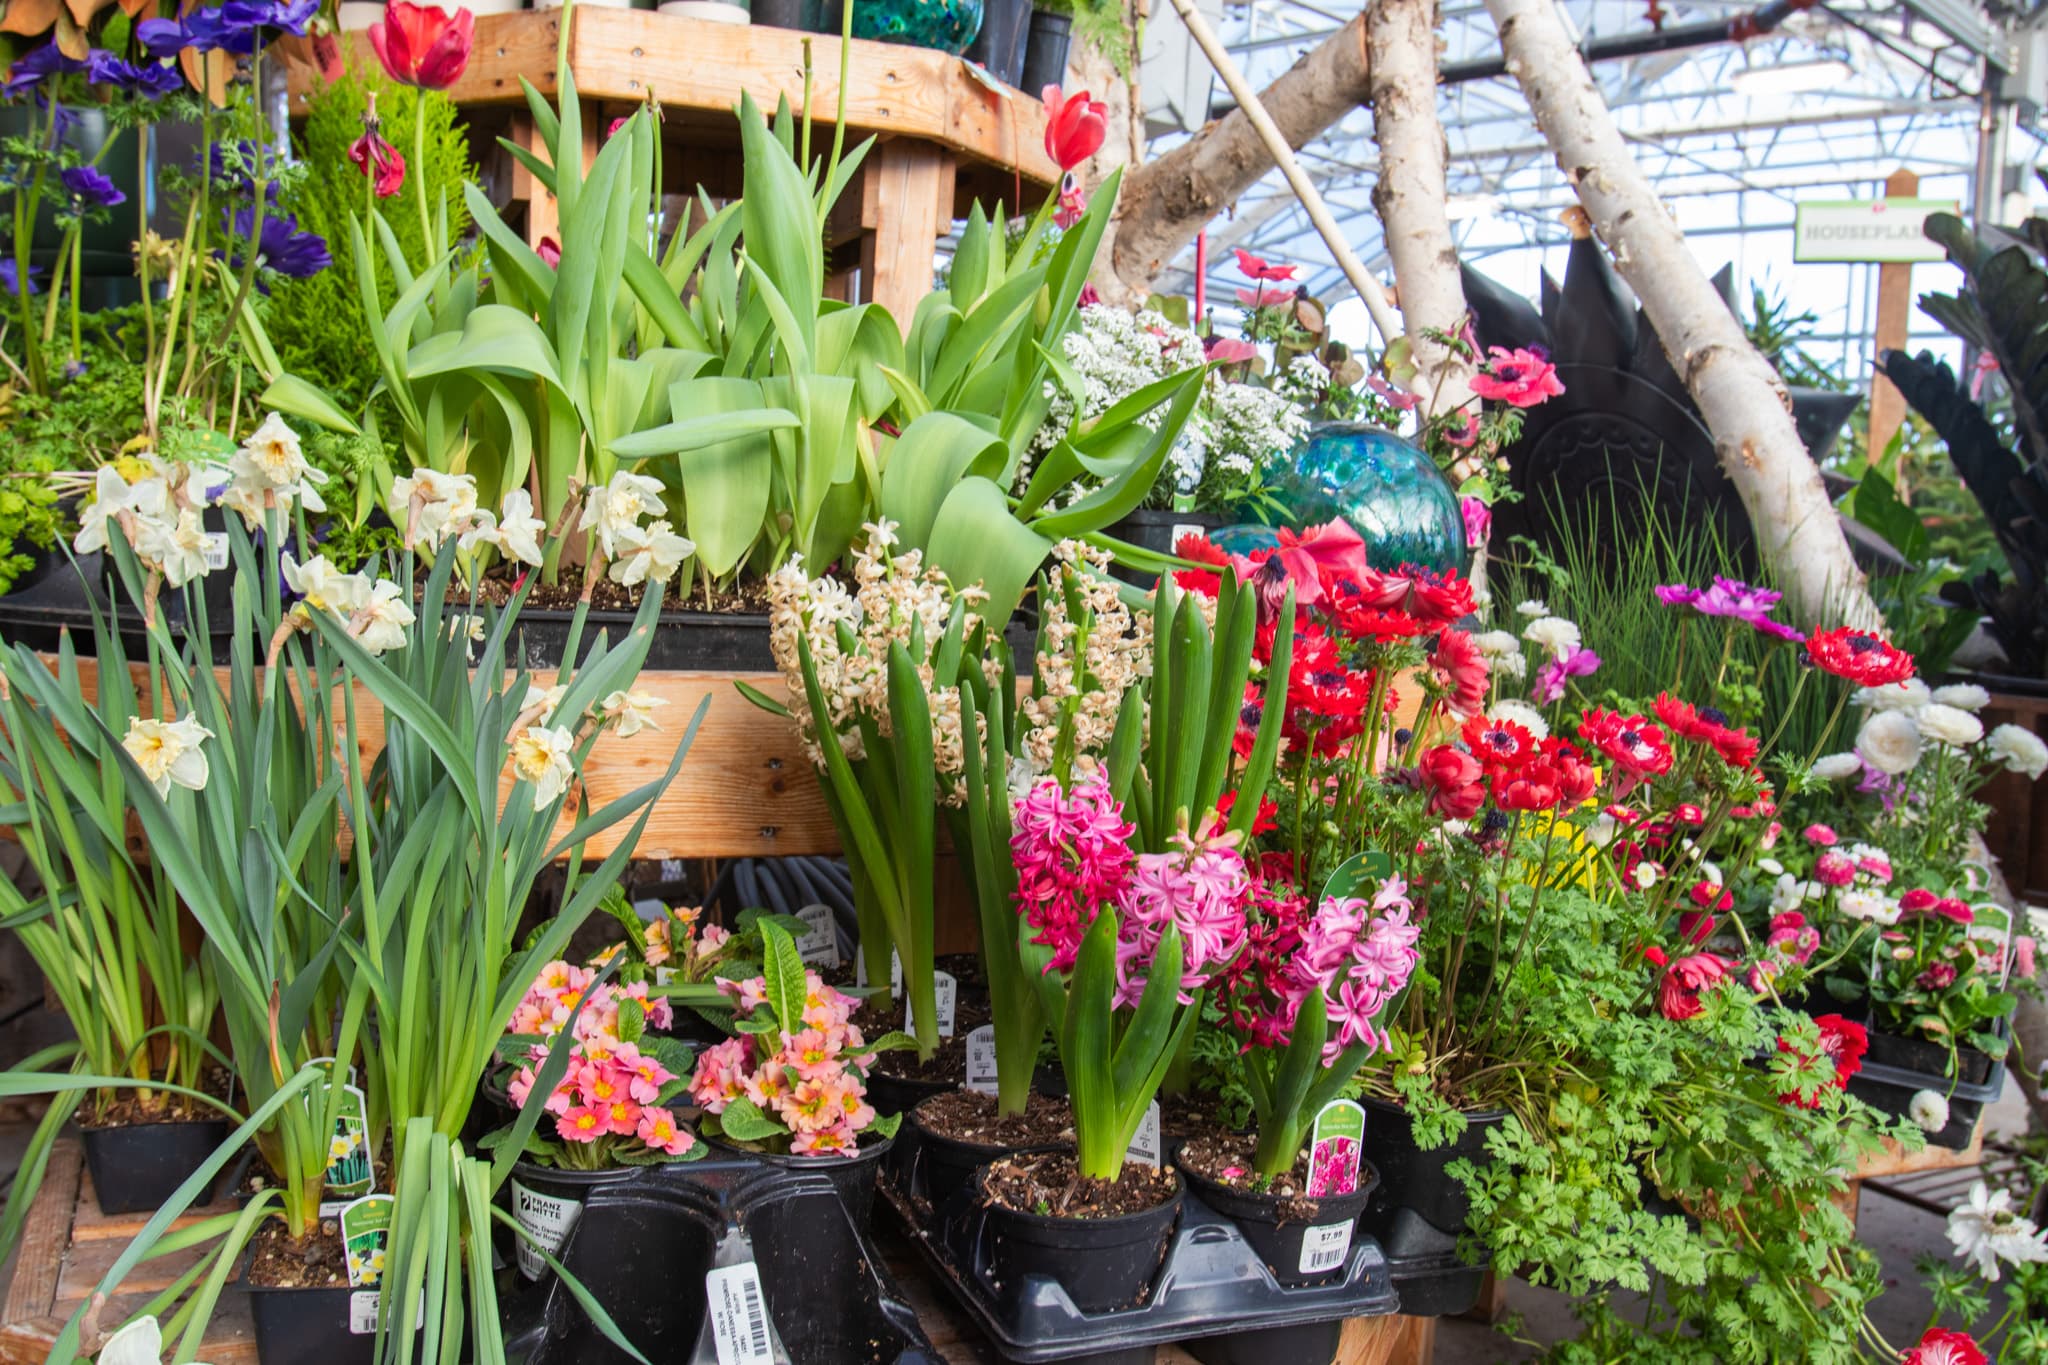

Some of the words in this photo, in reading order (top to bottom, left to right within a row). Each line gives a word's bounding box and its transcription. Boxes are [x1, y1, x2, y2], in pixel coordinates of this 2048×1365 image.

[1805, 224, 1923, 241] HOUSEPLAN
[532, 1197, 561, 1210] FRANZ
[532, 1207, 561, 1220] WITTE
[1321, 1231, 1343, 1241] $7.99
